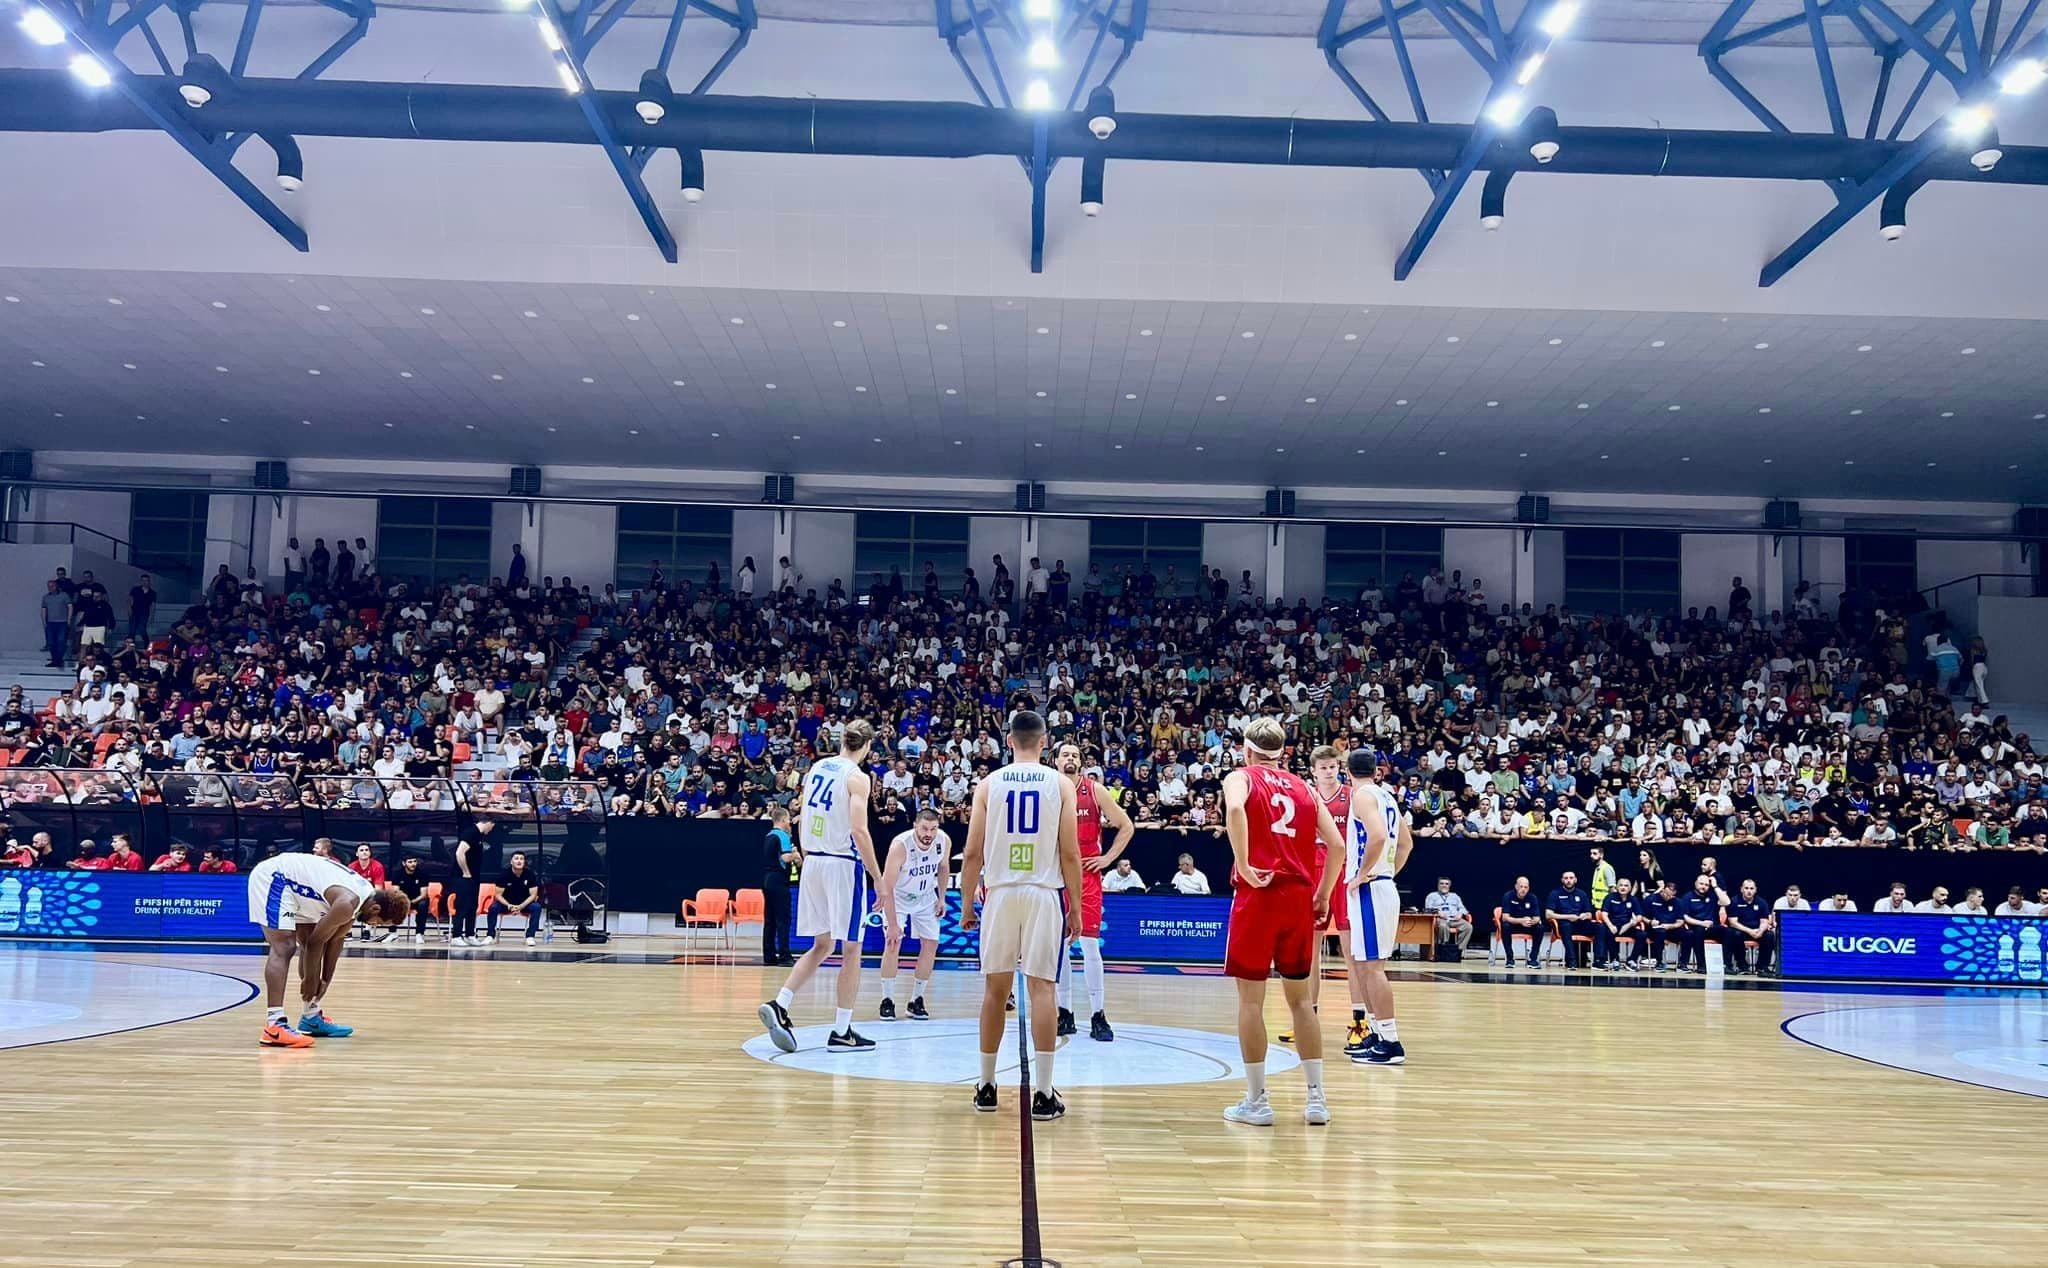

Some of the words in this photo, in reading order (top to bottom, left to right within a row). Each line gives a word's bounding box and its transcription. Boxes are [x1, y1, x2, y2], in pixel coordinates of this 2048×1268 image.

[808, 774, 835, 811] 24
[1005, 790, 1040, 834] 10
[1270, 792, 1297, 838] 2
[908, 863, 938, 877] KOSOV
[919, 879, 927, 891] 11
[135, 898, 141, 906] E
[142, 898, 172, 907] PIFSHI
[193, 899, 223, 908] SHNET
[163, 907, 181, 915] FOR
[182, 908, 216, 916] HEALTH
[1140, 920, 1145, 928] E
[1147, 920, 1175, 929] PIFSHI
[1195, 921, 1223, 930] SHNET
[1139, 928, 1165, 936] DRINK
[1167, 928, 1184, 937] FOR
[1185, 929, 1217, 938] HEALTH
